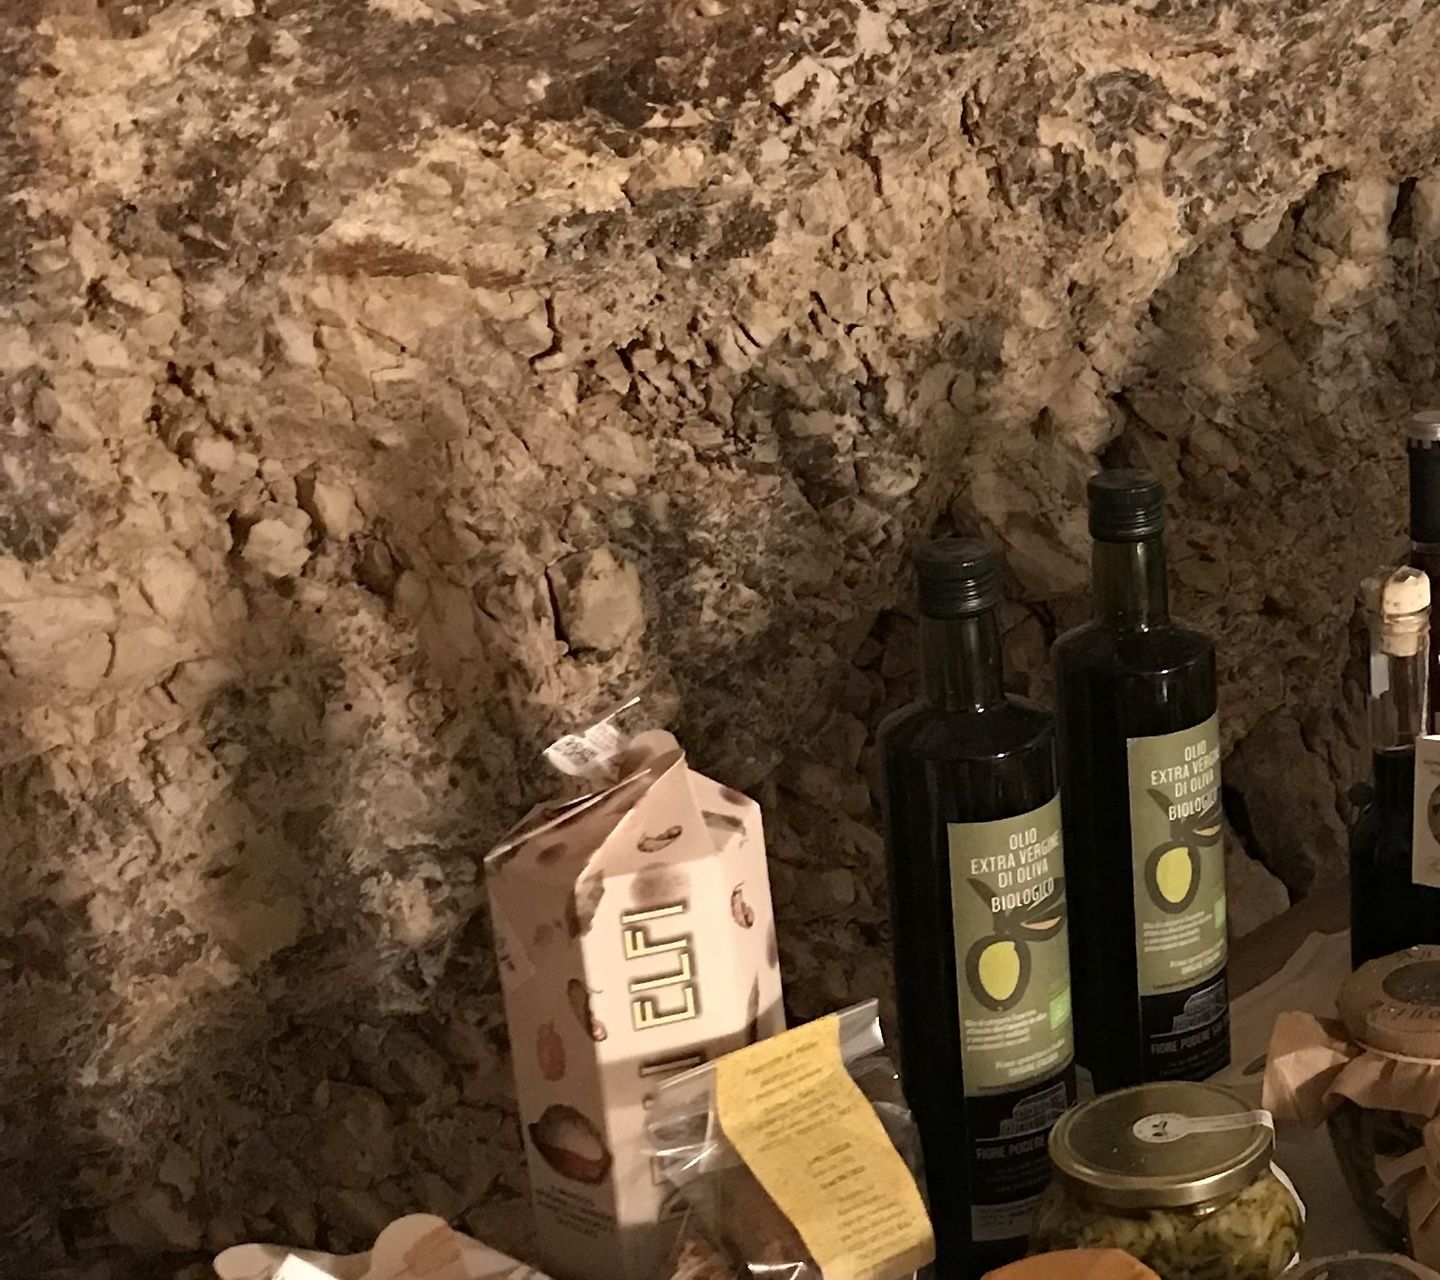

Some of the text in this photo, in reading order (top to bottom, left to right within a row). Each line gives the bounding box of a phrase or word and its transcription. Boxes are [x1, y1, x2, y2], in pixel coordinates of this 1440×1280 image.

[1185, 740, 1206, 761] OLIO
[1151, 764, 1189, 785] EXTRA
[1175, 781, 1187, 798] DI
[1009, 827, 1037, 850] OLIO
[970, 852, 1016, 875] EXTRA
[998, 857, 1049, 889] DI OLIVA
[991, 876, 1054, 913] BIOLOGICO
